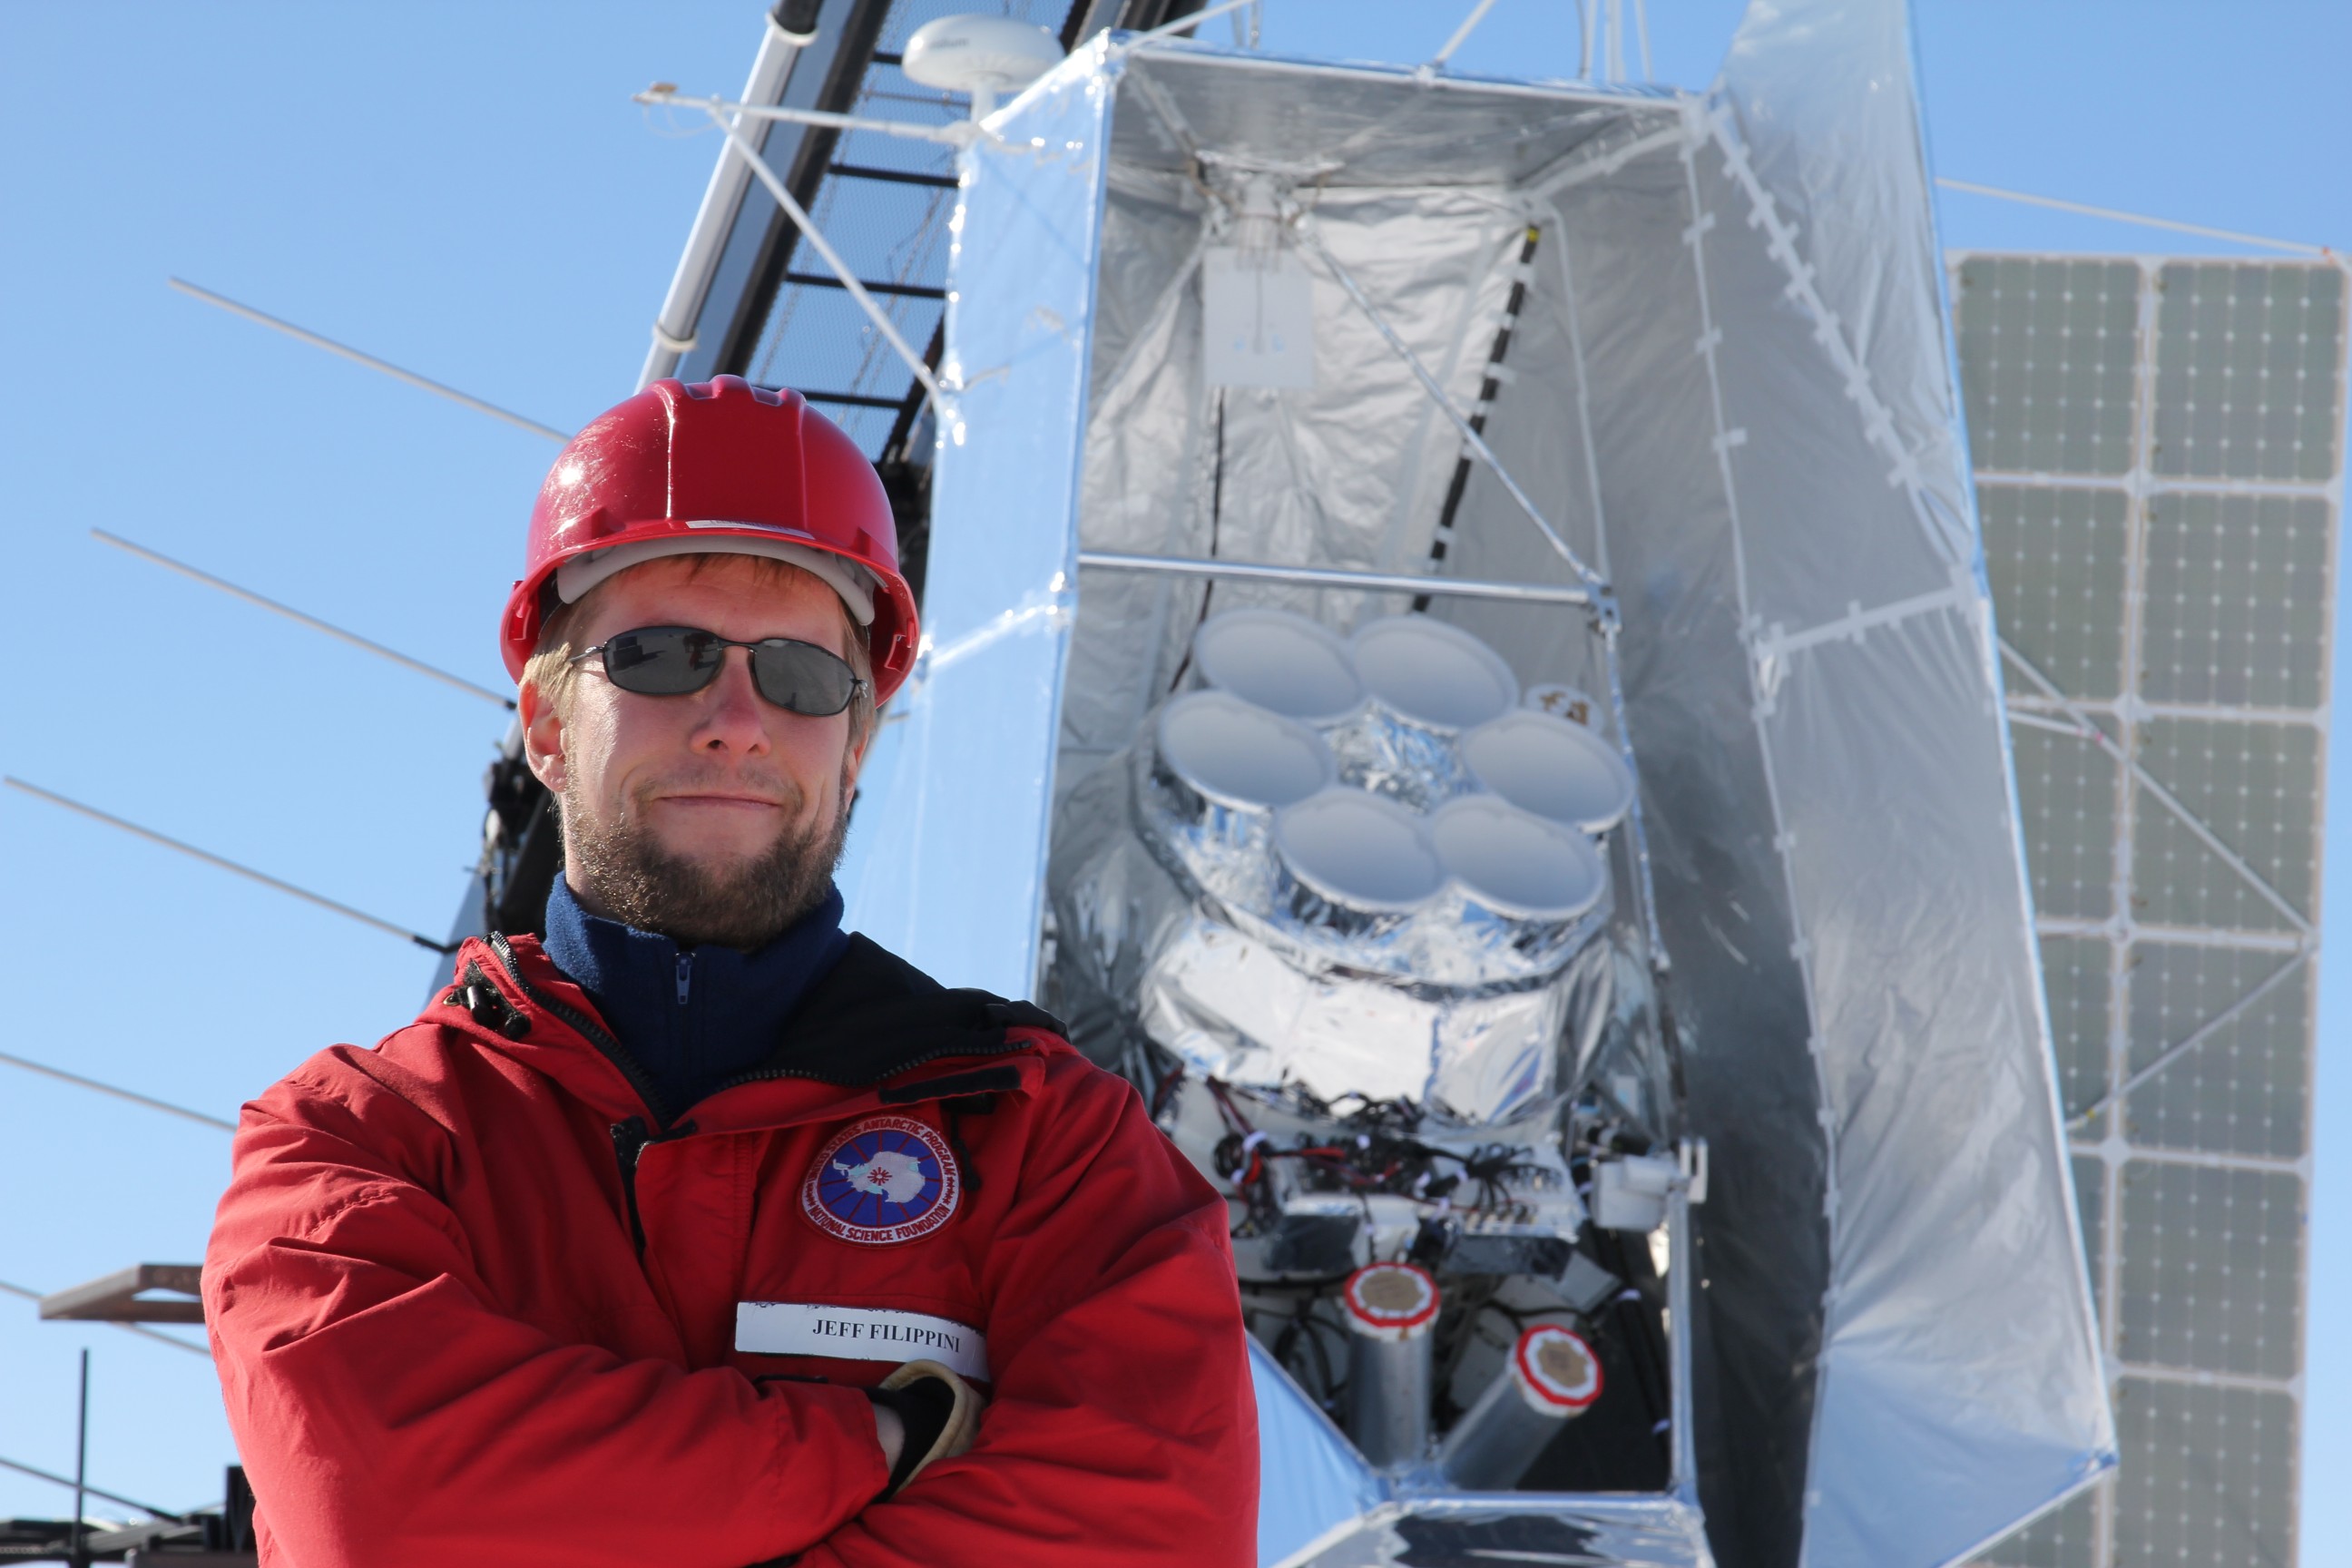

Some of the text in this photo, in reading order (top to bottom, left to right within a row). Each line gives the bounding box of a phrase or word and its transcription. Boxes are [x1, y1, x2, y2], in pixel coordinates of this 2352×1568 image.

[808, 1118, 956, 1182] UNITED STATES ANTARCTIC PROGRAM
[808, 1203, 950, 1241] NATIONAL SCIENCE FOUNDATION
[812, 1319, 960, 1353] JEFF FILIPPINI
